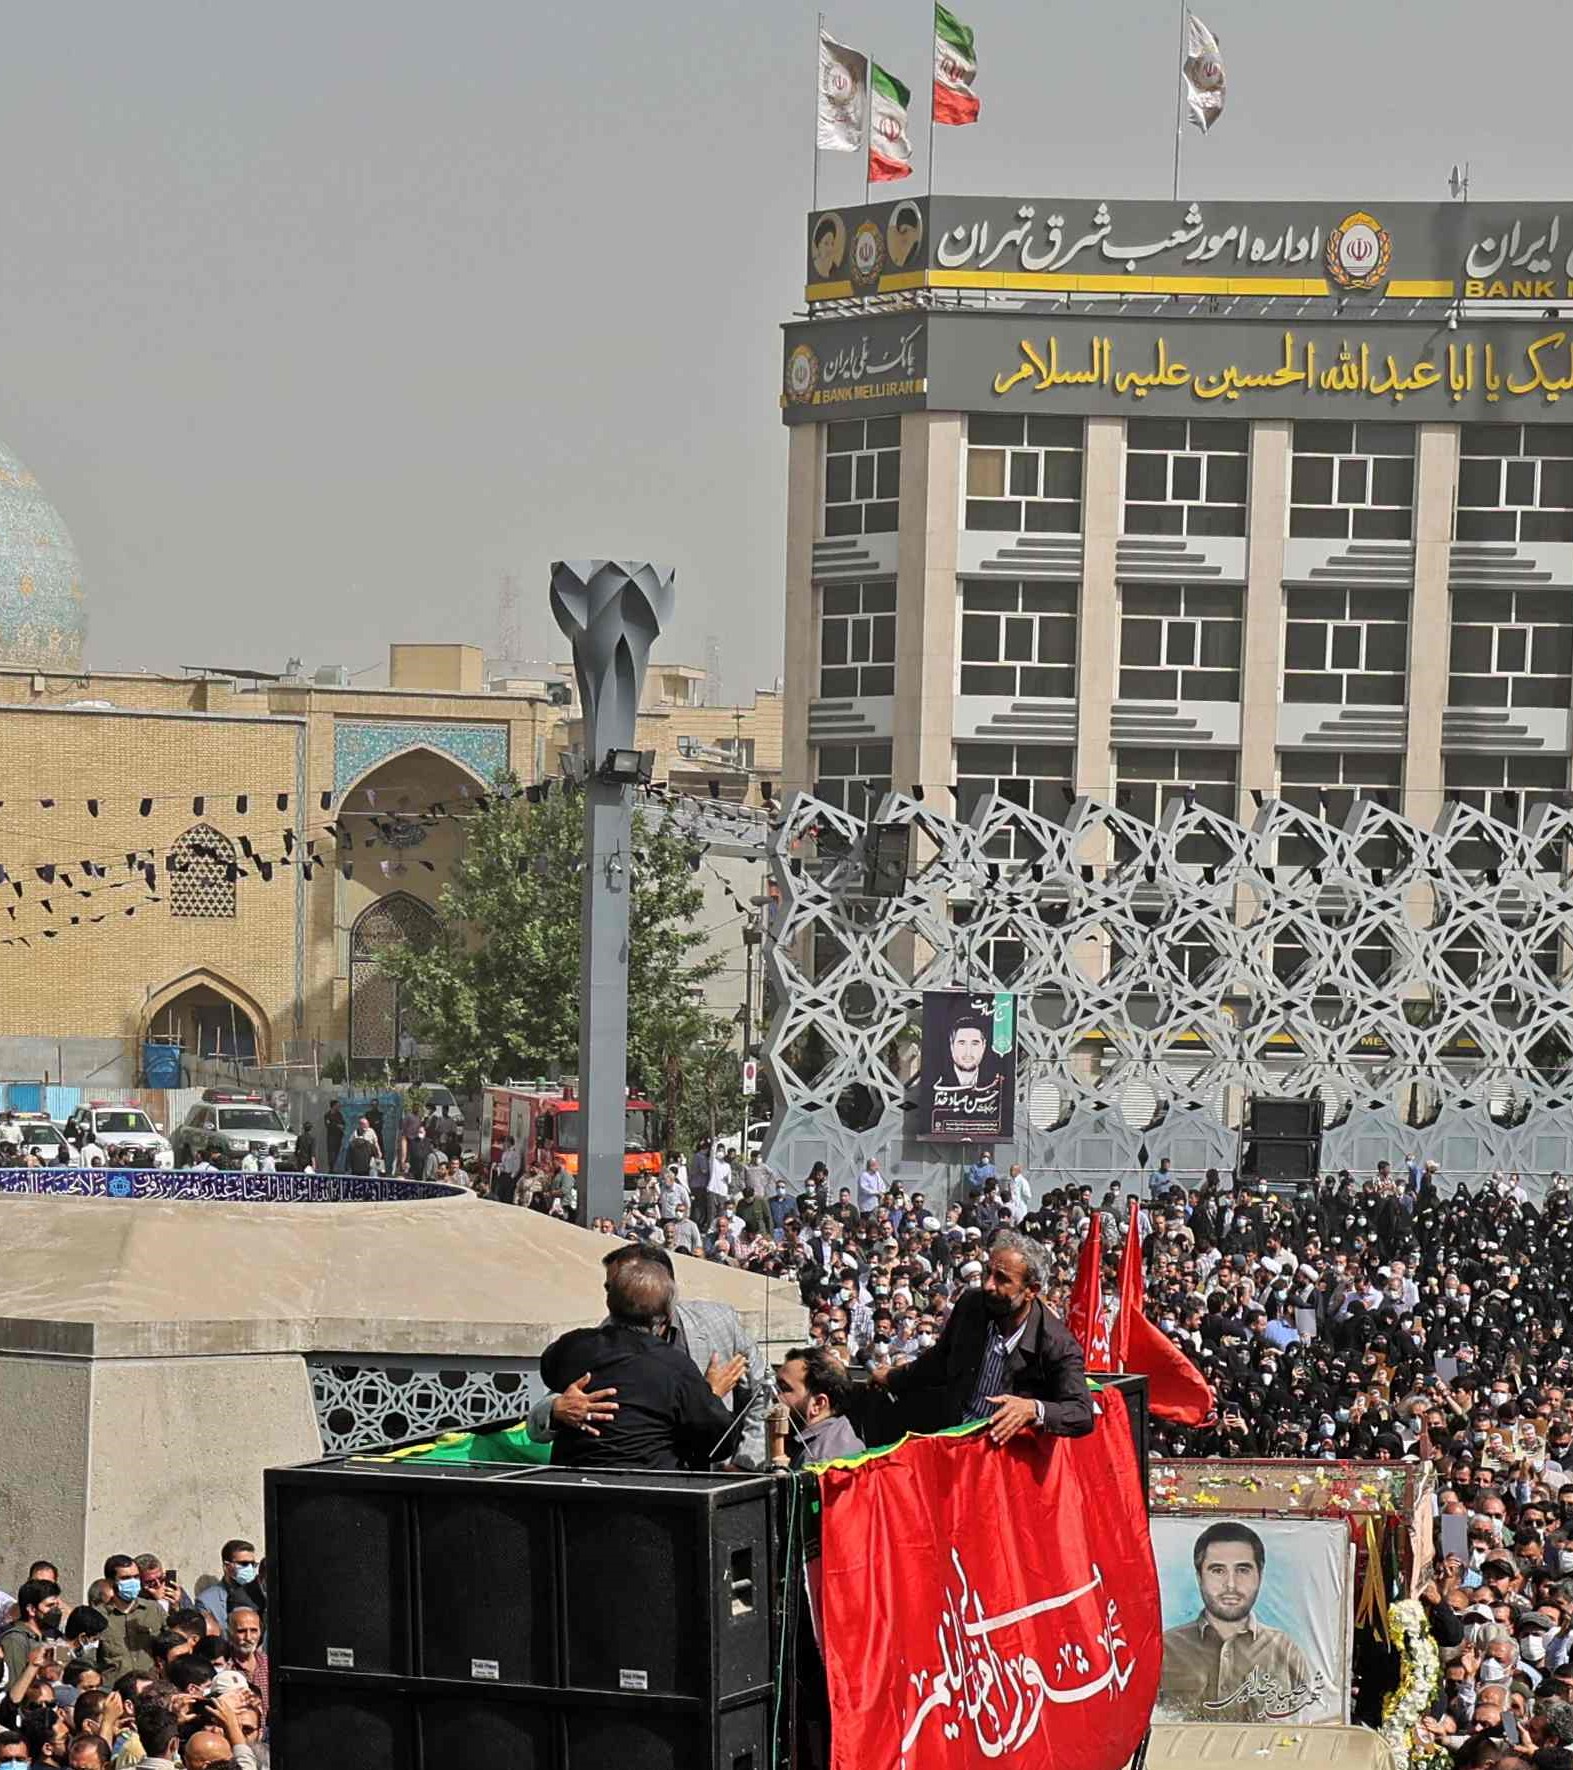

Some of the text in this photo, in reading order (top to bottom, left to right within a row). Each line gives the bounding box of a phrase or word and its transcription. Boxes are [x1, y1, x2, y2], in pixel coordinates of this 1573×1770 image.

[937, 202, 1319, 271] اداره امور شعب شرق تهران
[1465, 215, 1560, 279] ایران
[1465, 280, 1558, 298] BANK
[823, 381, 913, 403] BANK MELLI IRAN
[824, 345, 854, 382] ایران
[994, 336, 1111, 393] السلام
[1115, 337, 1191, 397] علیه
[1194, 331, 1316, 399] الحسین
[1449, 343, 1474, 400] ابا
[1484, 343, 1501, 401] یا
